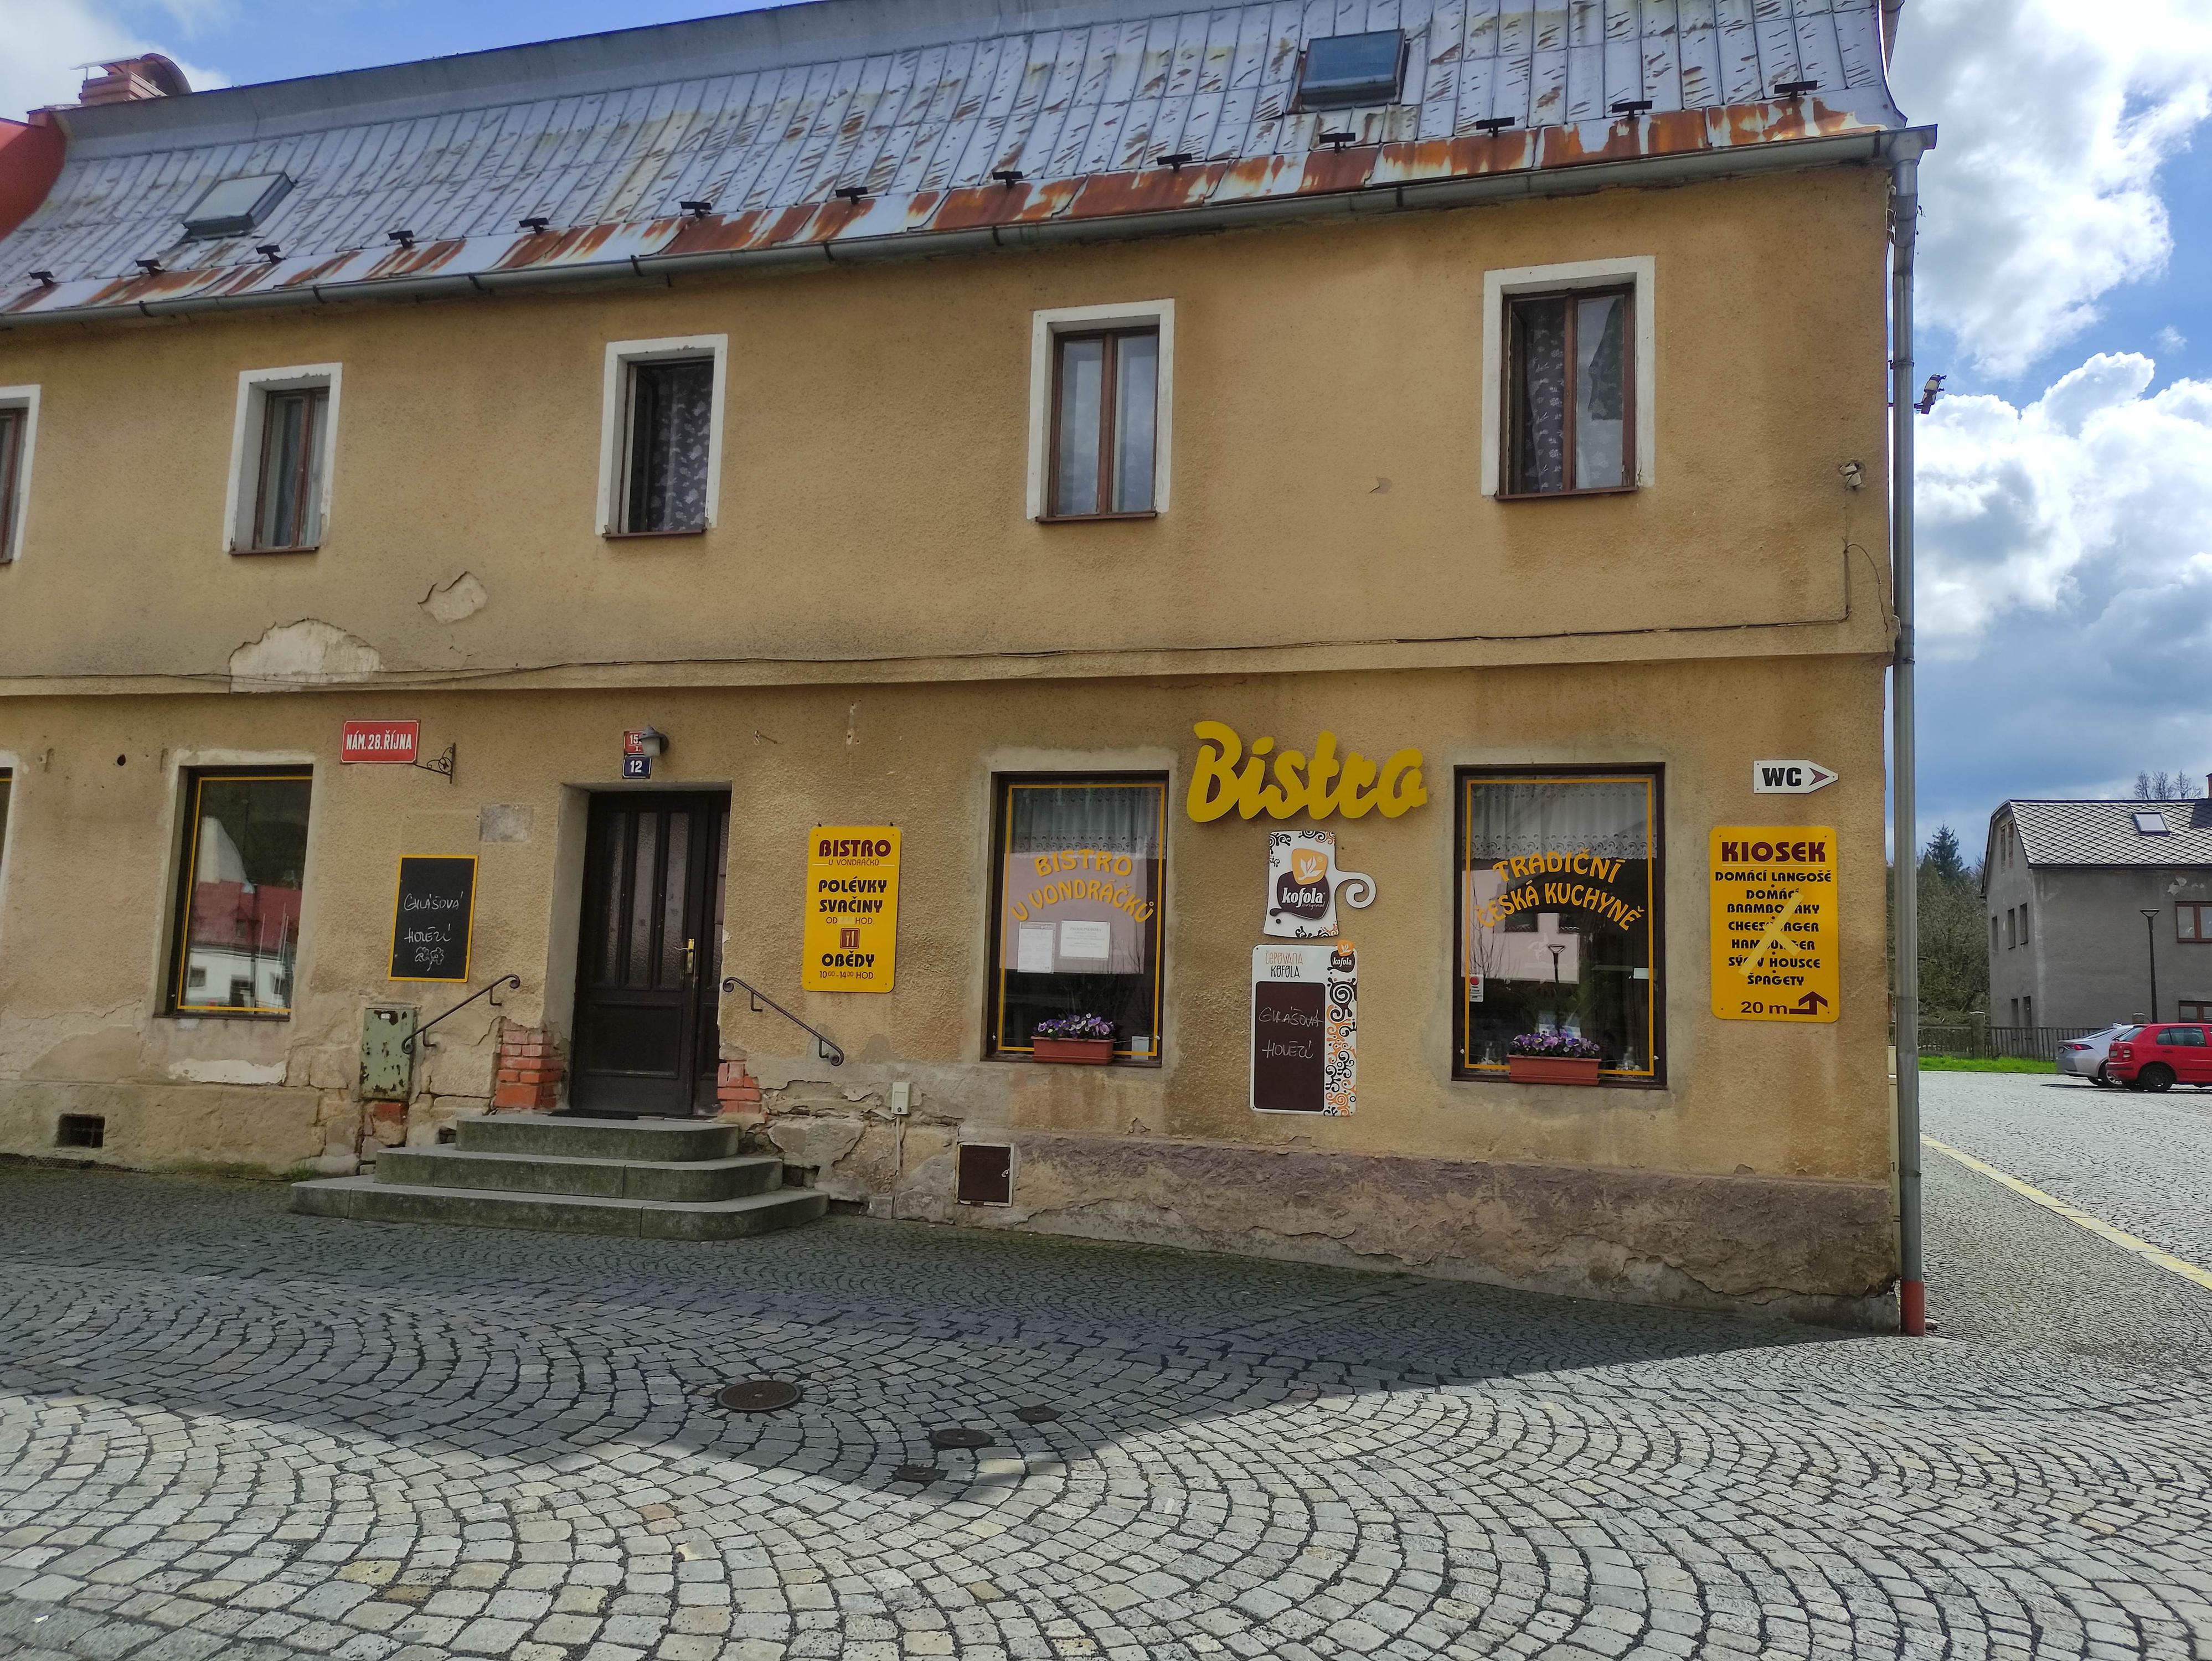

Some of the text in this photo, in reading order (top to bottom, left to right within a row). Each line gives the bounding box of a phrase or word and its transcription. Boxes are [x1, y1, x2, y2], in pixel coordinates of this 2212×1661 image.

[346, 730, 412, 750] NÁM. 28. ŘÍJNA
[630, 734, 642, 744] 15
[630, 760, 642, 773] 12
[1762, 767, 1802, 787] WC
[819, 839, 891, 857] BISTRO
[1721, 842, 1826, 863] KIOSEK
[1034, 848, 1132, 877] BISTRO
[1492, 848, 1626, 884] TRADIČNÍ
[1715, 869, 1831, 882] DOMÁCÍ LANGOŠĚ
[818, 876, 887, 893] POLÉVKY
[819, 896, 883, 913] SVAČINY
[1010, 879, 1154, 923] U VONDRÁČKŮ
[1281, 887, 1324, 908] kofola
[1476, 879, 1646, 931] ČESKÁ KUCHYNĚ
[1727, 902, 1819, 914] BRAMBOÁKY
[1728, 921, 1819, 932] CHEESRGER
[822, 950, 875, 967] OBĚDY
[1333, 957, 1353, 967] kofola
[1769, 957, 1821, 968] HOUSCE
[1271, 965, 1300, 978] KOFOLA
[1747, 972, 1804, 986] ŠPAGETY
[1741, 1001, 1787, 1014] 20 m
